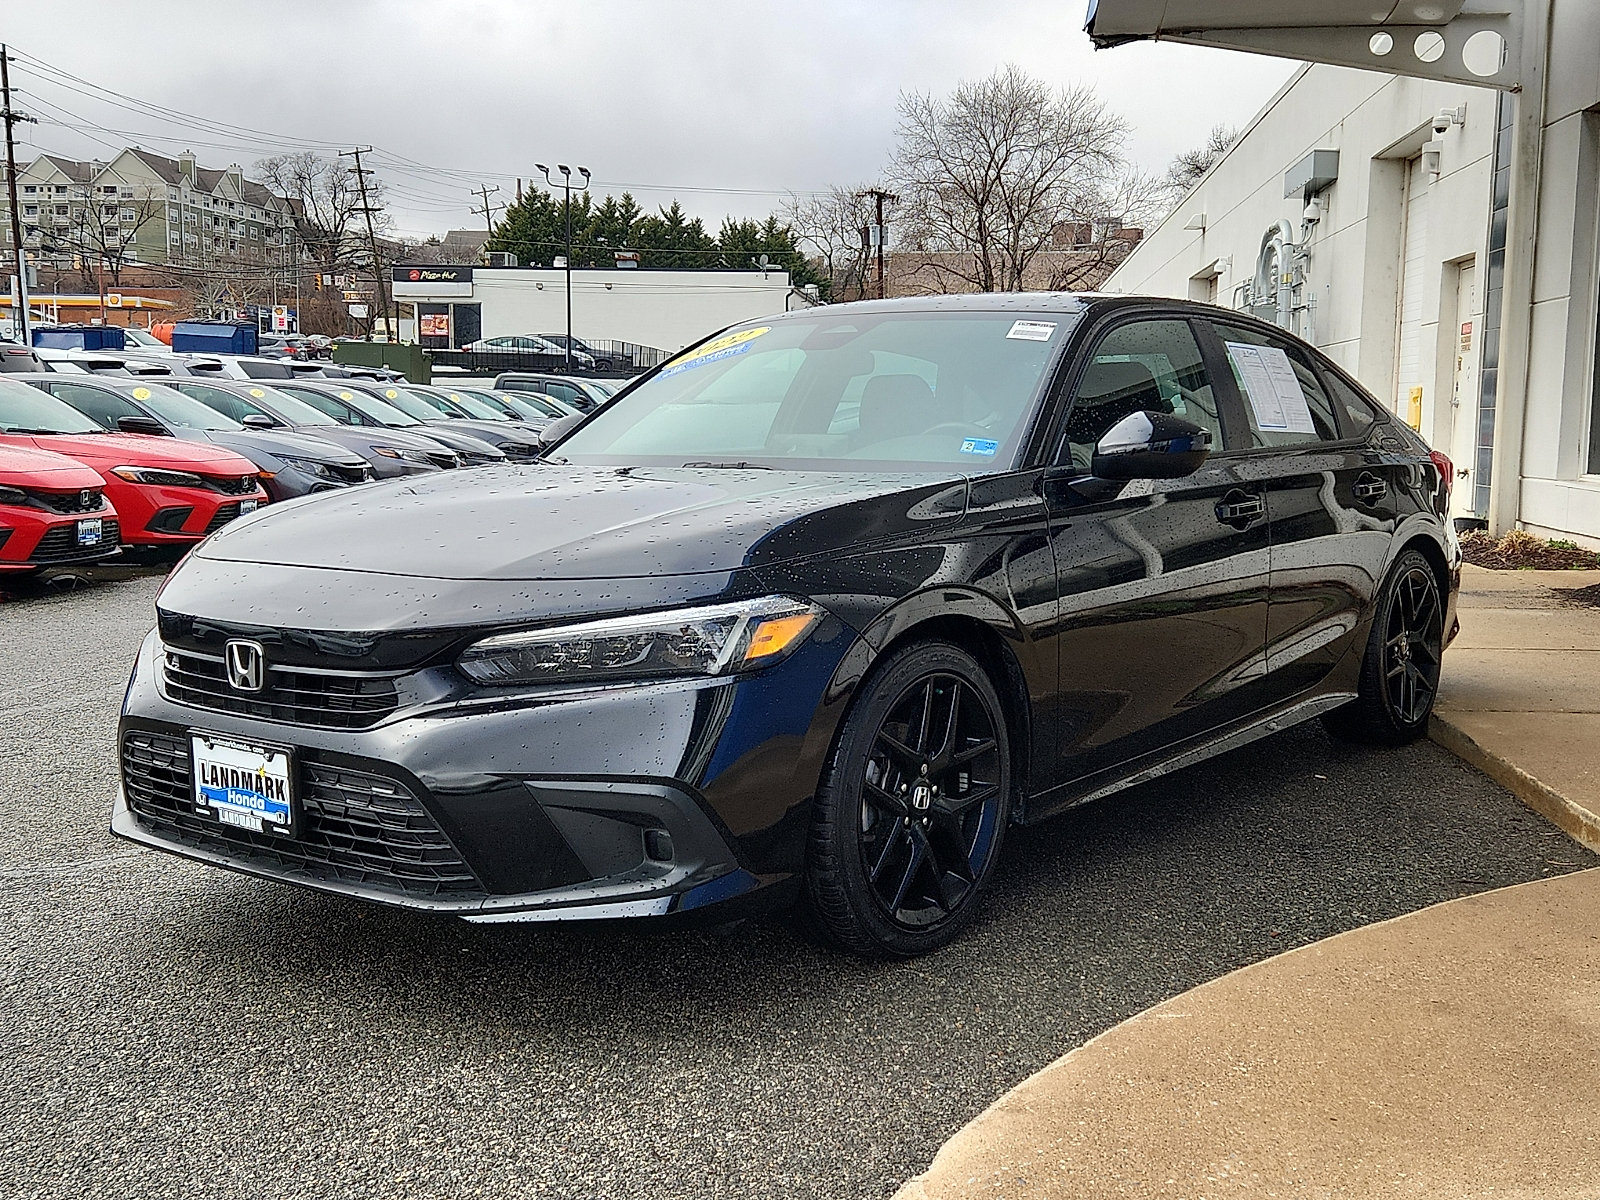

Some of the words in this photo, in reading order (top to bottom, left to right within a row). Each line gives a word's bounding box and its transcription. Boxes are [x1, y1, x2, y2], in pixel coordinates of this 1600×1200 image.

[421, 271, 441, 280] Pizza
[441, 271, 458, 280] Hut
[201, 763, 286, 802] LANDMARK
[227, 789, 265, 810] Honda
[220, 809, 263, 832] LANDMARK
